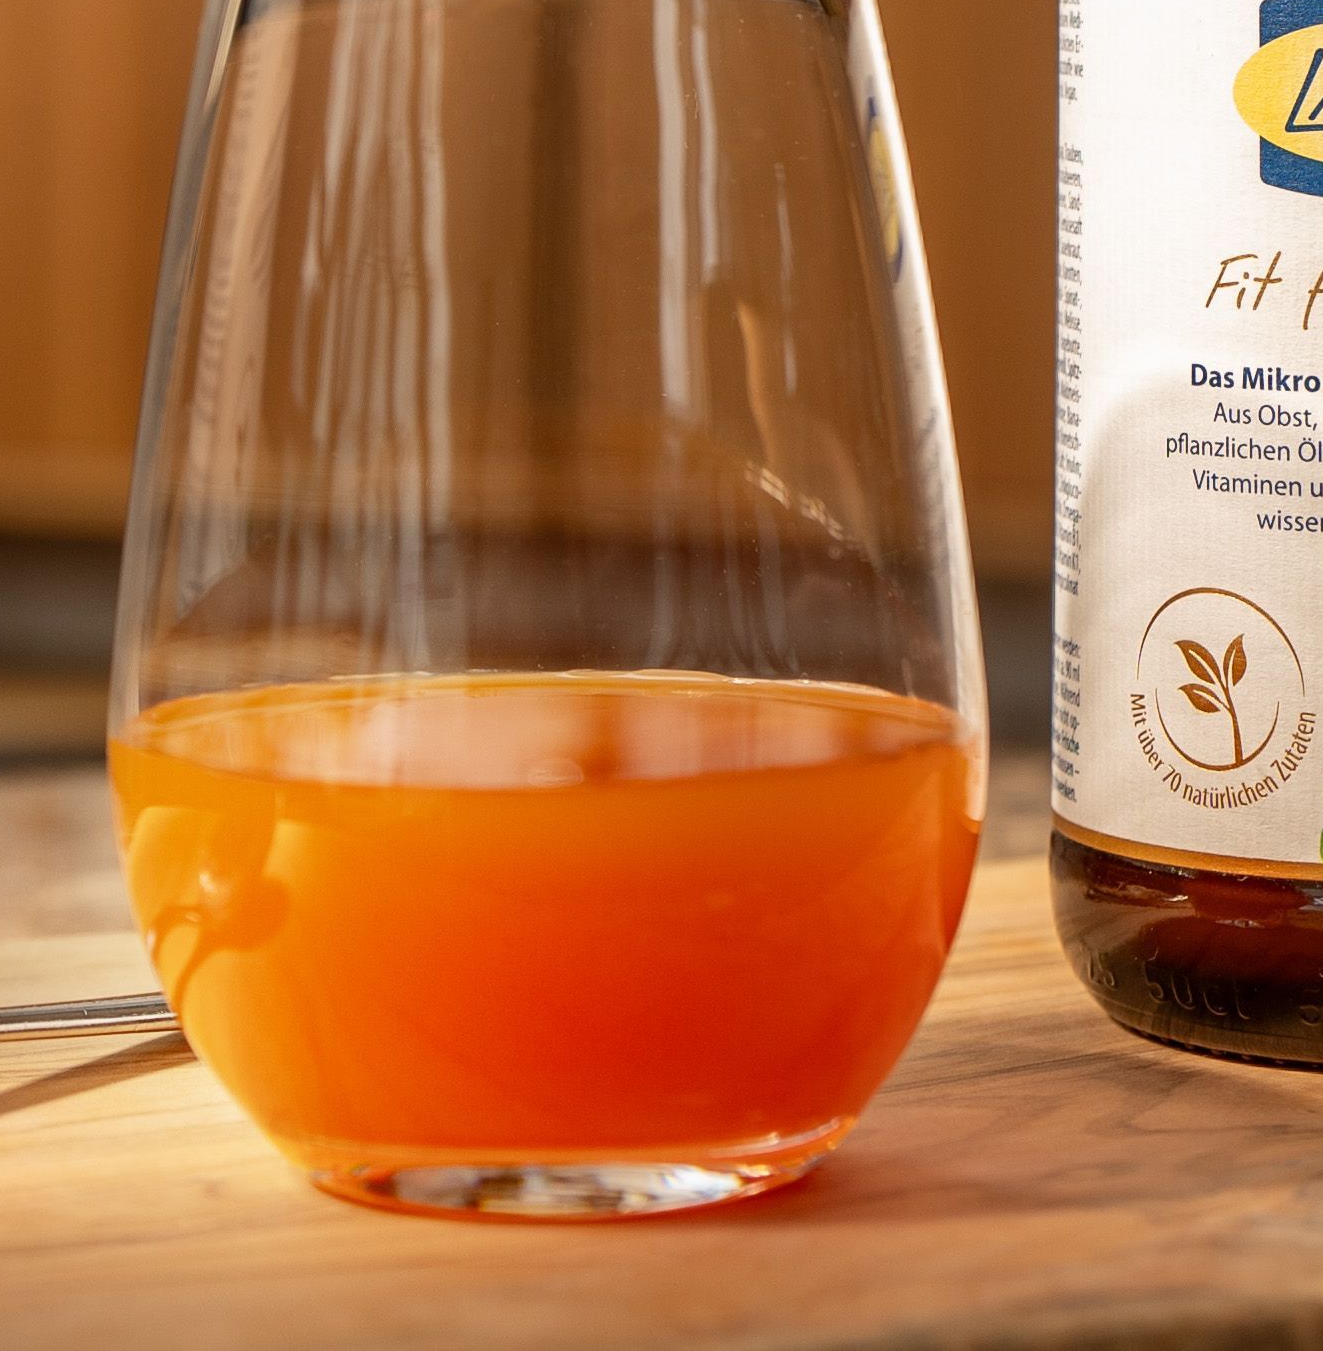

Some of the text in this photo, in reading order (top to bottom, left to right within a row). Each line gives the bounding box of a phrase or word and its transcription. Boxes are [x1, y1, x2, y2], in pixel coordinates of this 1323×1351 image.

[1205, 250, 1283, 311] Fit
[1190, 363, 1235, 389] Das
[1213, 401, 1252, 425] Aus
[1258, 404, 1318, 432] Obst,
[1166, 432, 1291, 462] pflanzlichen
[1192, 468, 1302, 497] Vitaminen
[1130, 693, 1317, 809] Mit über 70 natürlichen Zutaten
